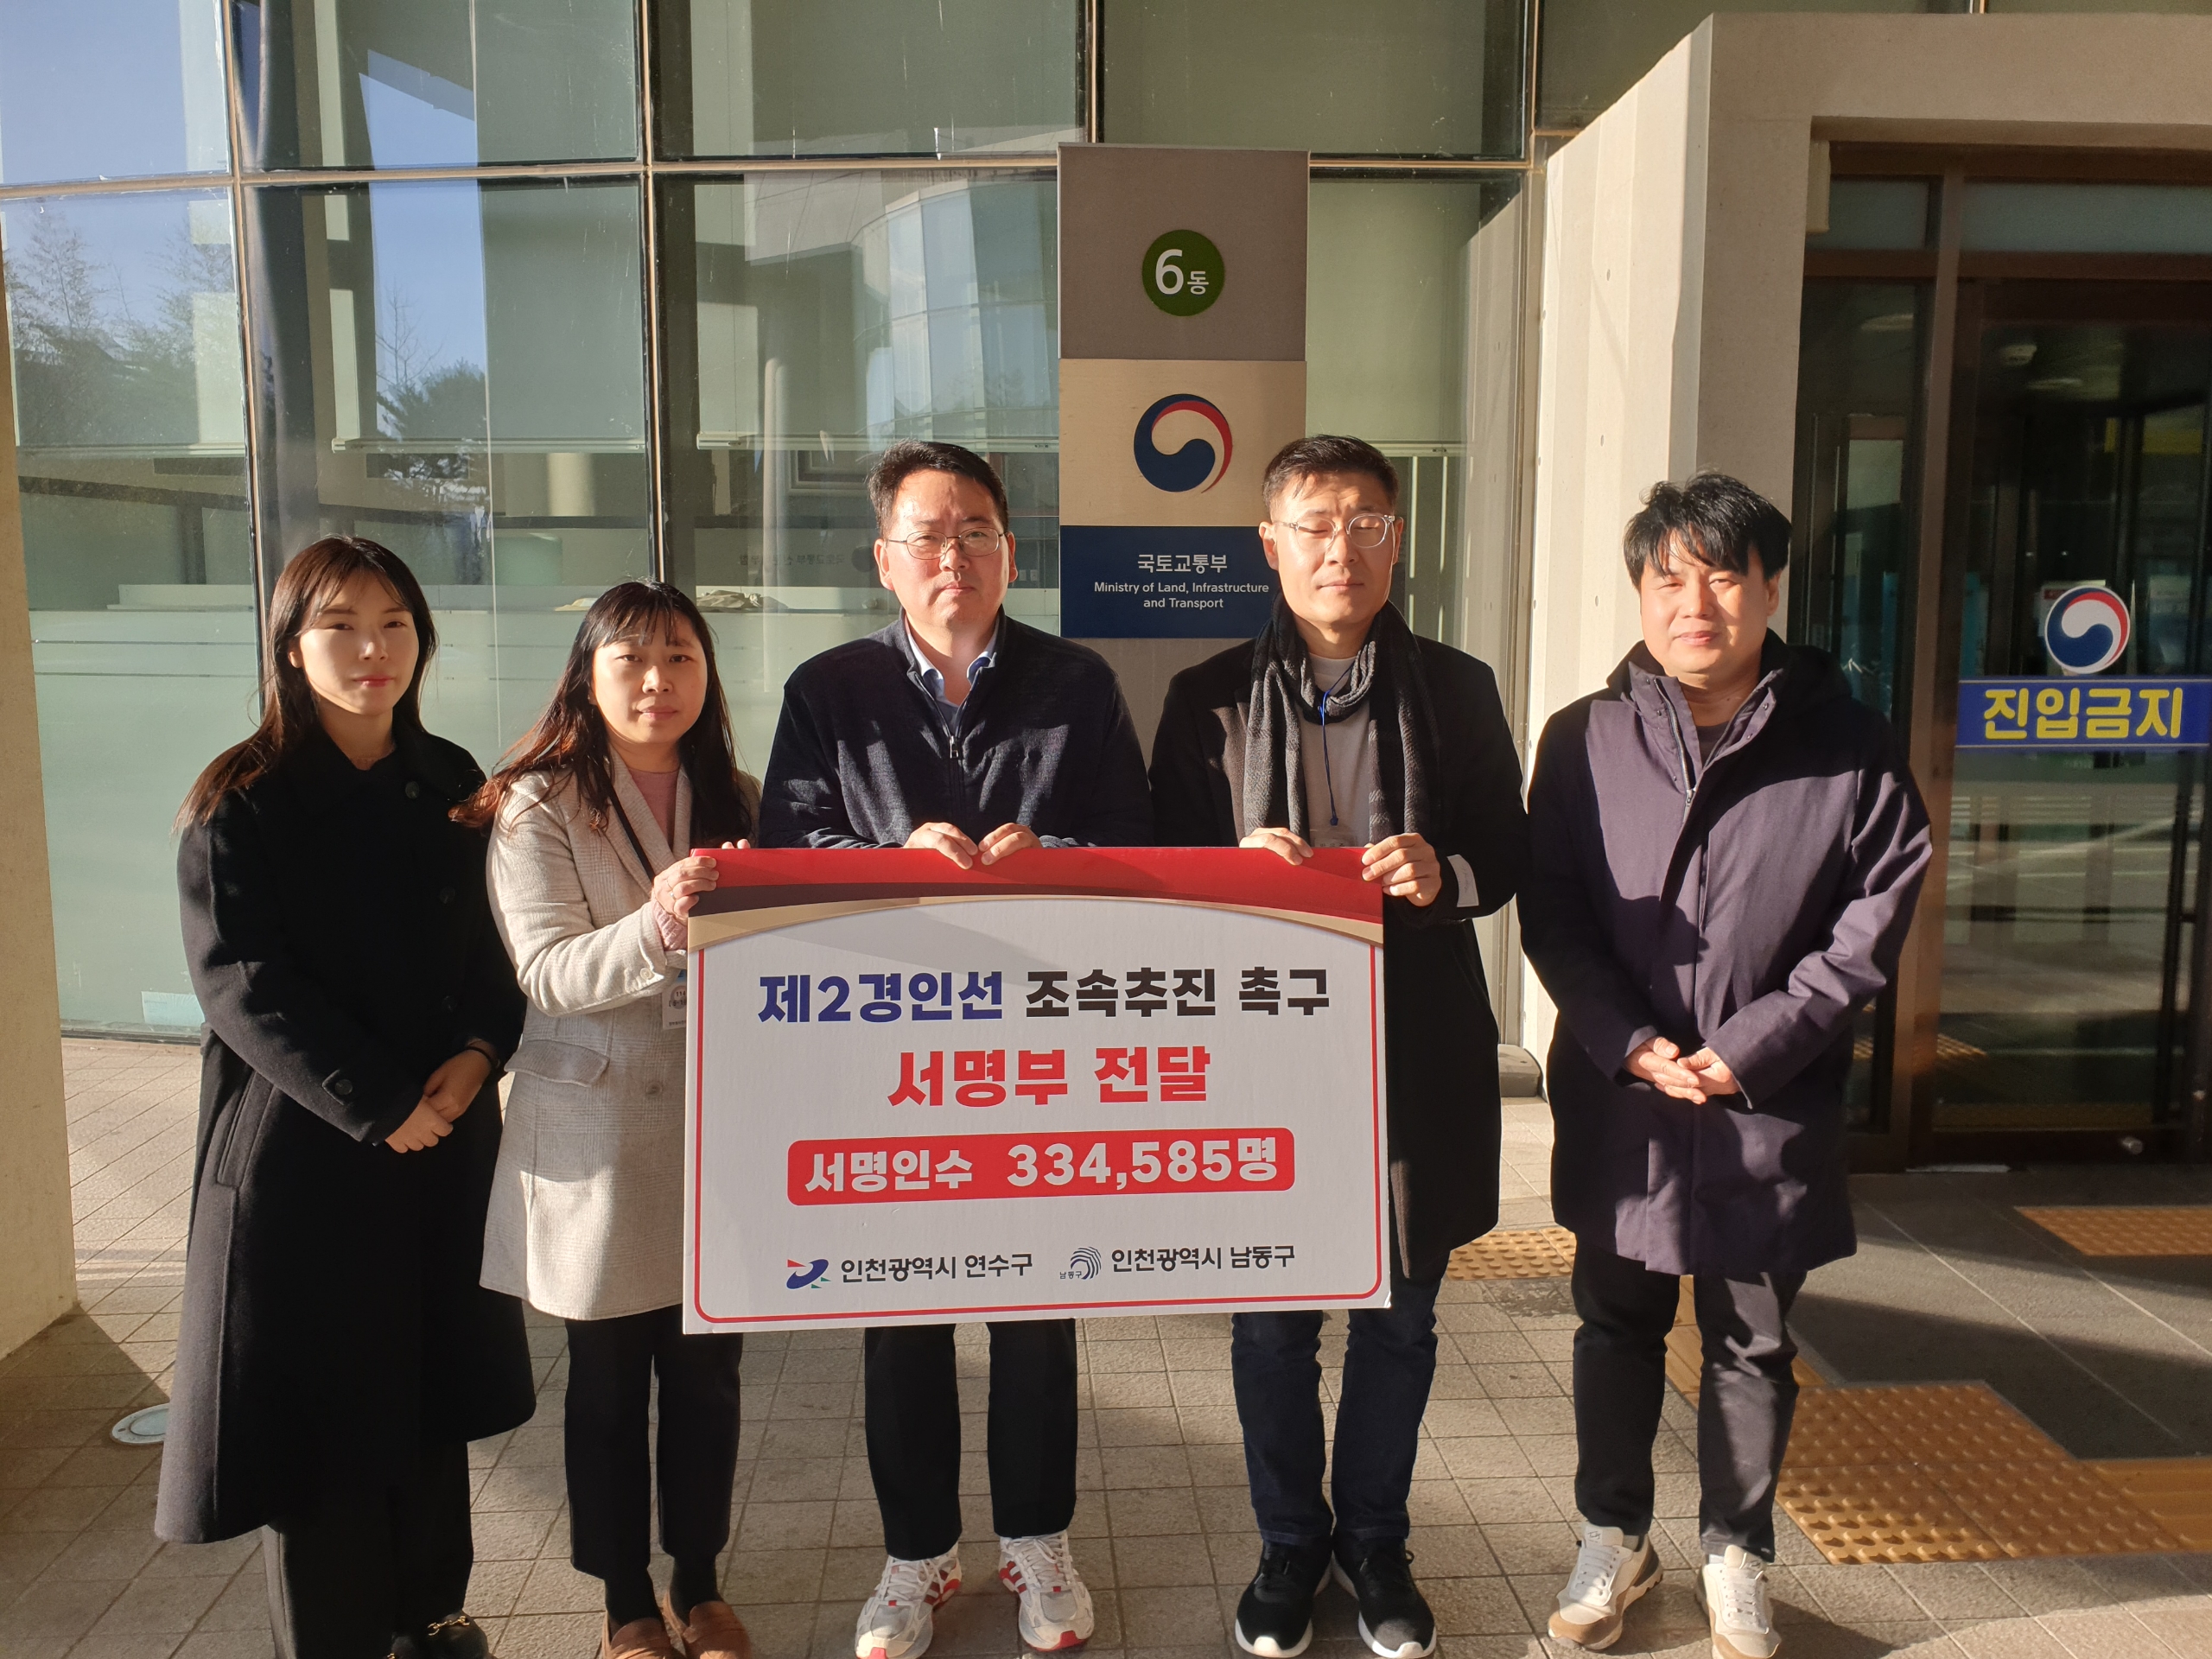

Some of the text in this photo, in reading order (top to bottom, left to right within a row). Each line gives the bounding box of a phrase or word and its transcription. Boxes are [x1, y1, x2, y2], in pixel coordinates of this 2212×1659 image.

[1155, 249, 1209, 295] 6동
[1137, 554, 1228, 575] 국토교통부
[1094, 582, 1269, 594] Ministry of Land, Infrastructure
[1143, 597, 1224, 610] and Transport
[1984, 688, 2183, 740] 진입금지
[757, 966, 1330, 1023] 제2경인선 조속추진 촉구
[887, 1046, 1211, 1109] 서명부 전달
[804, 1137, 1278, 1192] 서명인수 334,585명
[841, 1253, 1033, 1283] 인천광역시 연수구
[1111, 1245, 1295, 1273] 인천광역시 남동구
[1059, 1270, 1083, 1280] 남동구
